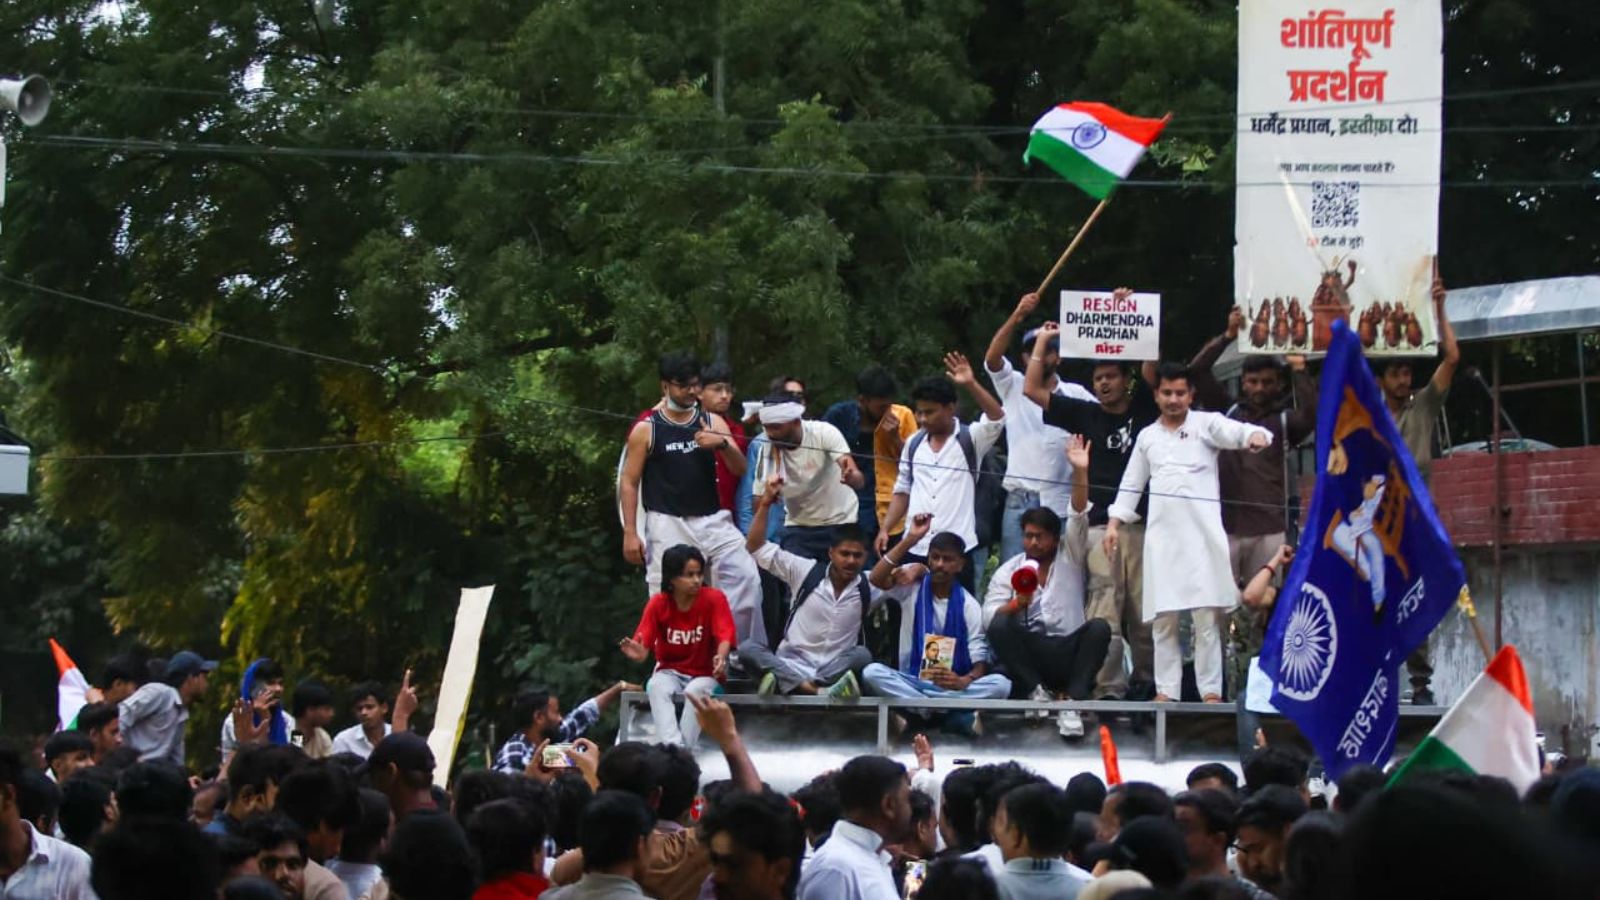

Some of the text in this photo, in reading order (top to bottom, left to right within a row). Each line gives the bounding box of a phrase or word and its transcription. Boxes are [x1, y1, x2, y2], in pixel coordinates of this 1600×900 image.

[1281, 9, 1395, 59] शांतिपूर्ण
[1287, 60, 1388, 104] प्रदर्शन
[1291, 118, 1336, 137] प्रधान,
[1084, 298, 1137, 312] RESIGN
[1066, 312, 1154, 327] DHARMENDRA
[1078, 327, 1139, 340] PRADHAN
[665, 442, 684, 452] NEW
